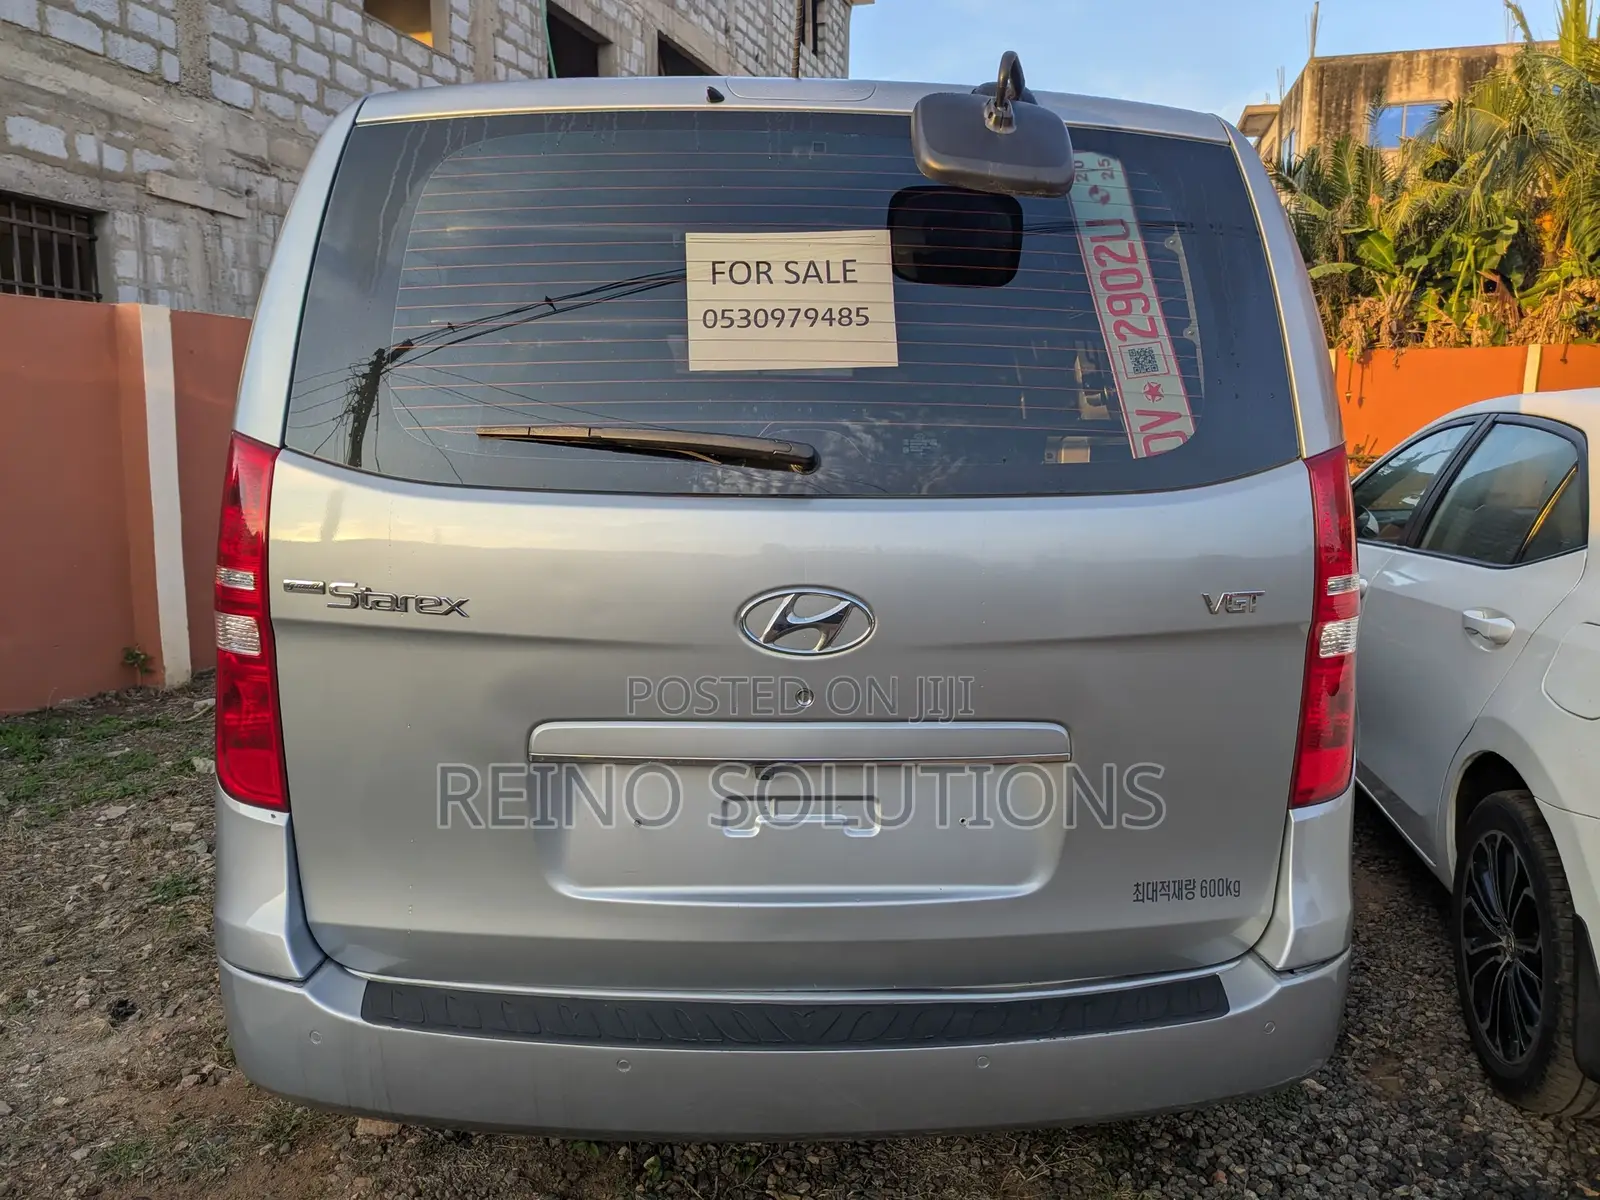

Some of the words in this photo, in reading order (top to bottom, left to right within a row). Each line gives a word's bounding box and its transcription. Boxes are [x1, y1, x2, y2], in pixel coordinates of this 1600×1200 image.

[1097, 157, 1115, 180] 25
[711, 260, 774, 285] FOR
[784, 259, 858, 284] SALE
[702, 307, 870, 328] 0530979485
[327, 582, 470, 618] Starex
[1201, 590, 1265, 614] VGT
[1133, 878, 1196, 903] 최대적재량
[1200, 878, 1241, 898] 600kg
